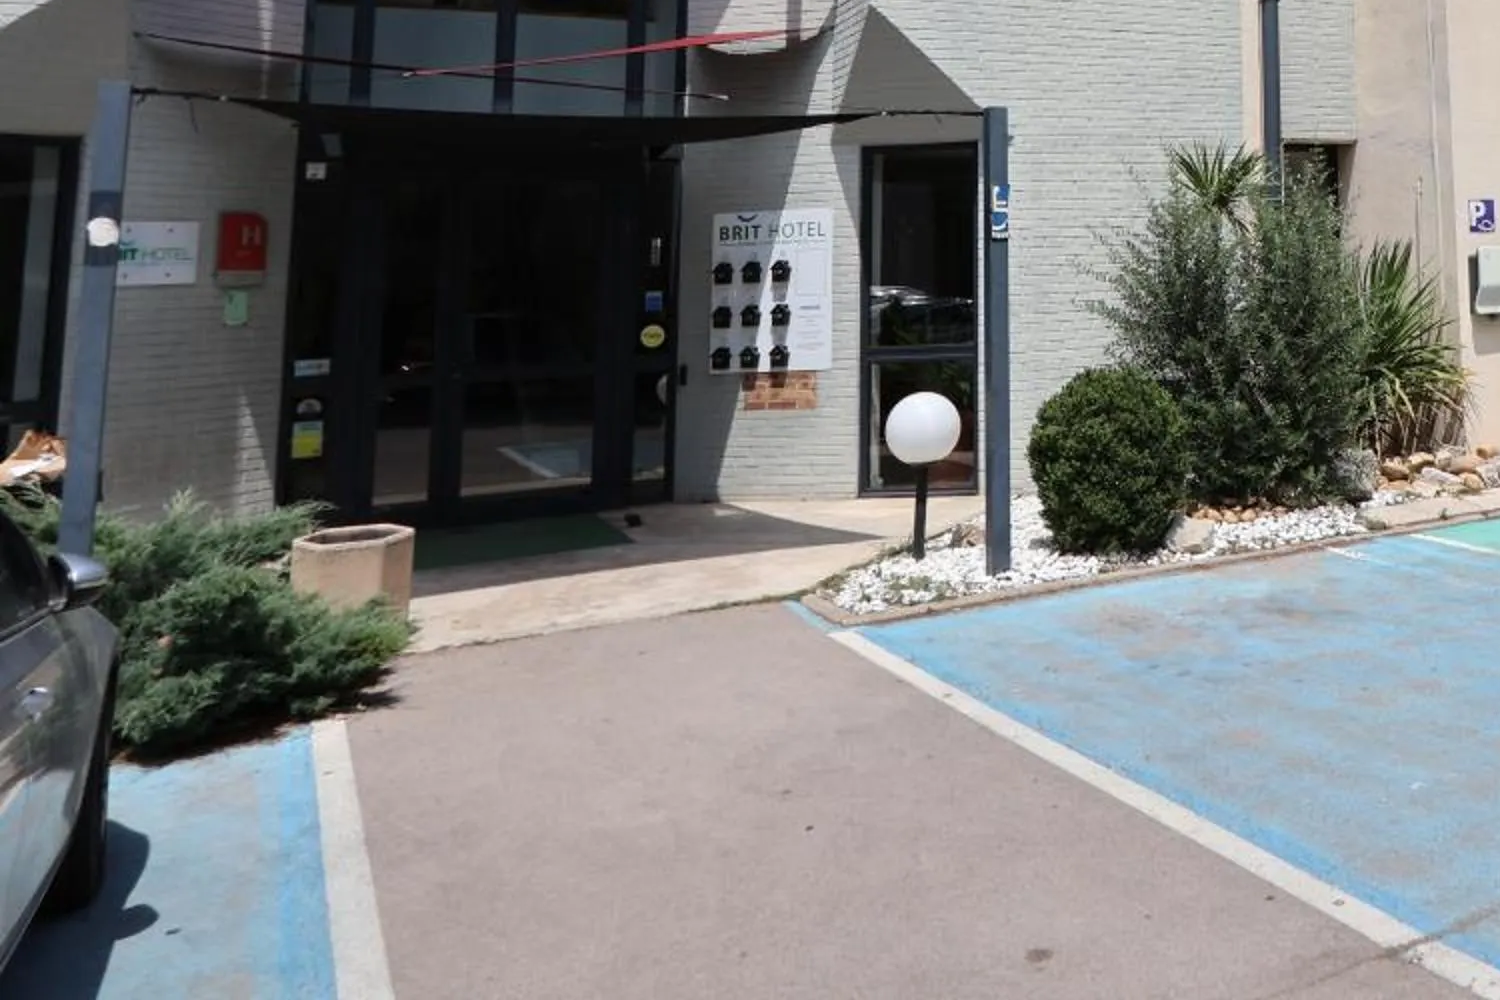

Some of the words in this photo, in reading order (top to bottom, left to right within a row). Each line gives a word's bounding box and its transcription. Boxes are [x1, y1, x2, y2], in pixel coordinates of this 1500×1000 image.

[1469, 201, 1486, 227] P
[719, 224, 761, 241] BRIT
[768, 221, 826, 239] HOTEL
